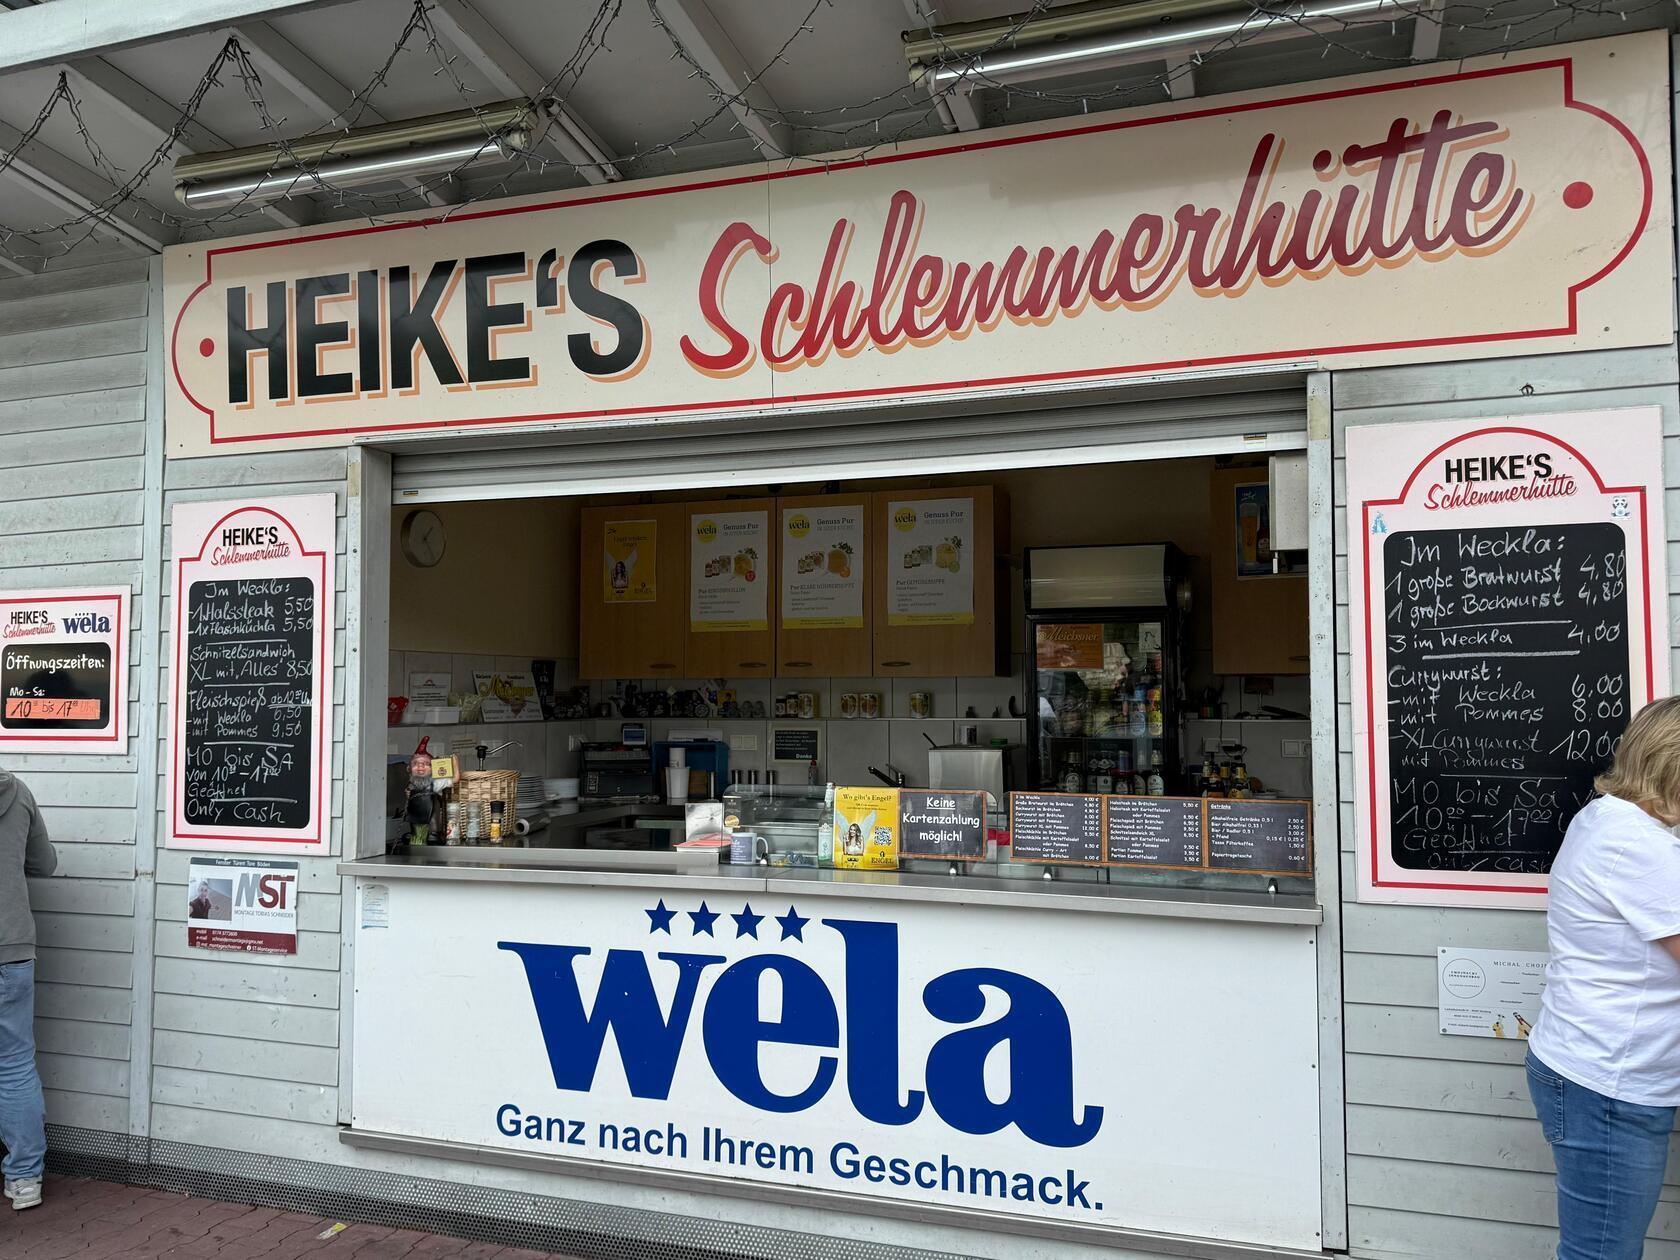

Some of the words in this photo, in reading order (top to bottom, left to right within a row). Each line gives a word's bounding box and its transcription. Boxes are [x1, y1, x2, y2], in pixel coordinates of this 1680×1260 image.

[226, 239, 648, 406] HEIKE‘S
[680, 109, 1528, 370] Schlemmerhütte
[1424, 473, 1578, 511] Schlemmerhütte
[211, 542, 291, 566] Schlemmerhütte
[1384, 572, 1402, 595] 1
[1461, 558, 1562, 589] Bratwurst
[1580, 549, 1626, 580] 4,80
[1388, 600, 1403, 624] 1
[1462, 586, 1565, 615] Bockwurst
[1578, 578, 1624, 607] 4,80
[1388, 634, 1407, 653] 3
[1568, 620, 1621, 645] 4,00
[6, 652, 105, 674] Öffnungszeiten:
[189, 662, 212, 683] XL
[9, 687, 25, 696] Mo
[1571, 674, 1624, 699] 6,00
[1572, 698, 1624, 723] 8,00
[214, 724, 259, 738] Pommes
[272, 721, 303, 738] 9,50
[187, 746, 213, 767] MO
[225, 746, 254, 768] bis
[926, 797, 956, 808] Keine
[1393, 777, 1440, 805] MO
[1455, 778, 1501, 806] bis
[187, 798, 224, 823] Only
[233, 802, 286, 824] Cash
[903, 813, 980, 829] Kartenzahlung
[919, 831, 963, 844] möglich!
[235, 873, 295, 910] MST
[497, 915, 1104, 1148] wela
[496, 1104, 586, 1146] Ganz
[598, 1122, 689, 1161] nach
[703, 1126, 814, 1175] Ihrem
[828, 1142, 1105, 1213] Geschmack.
